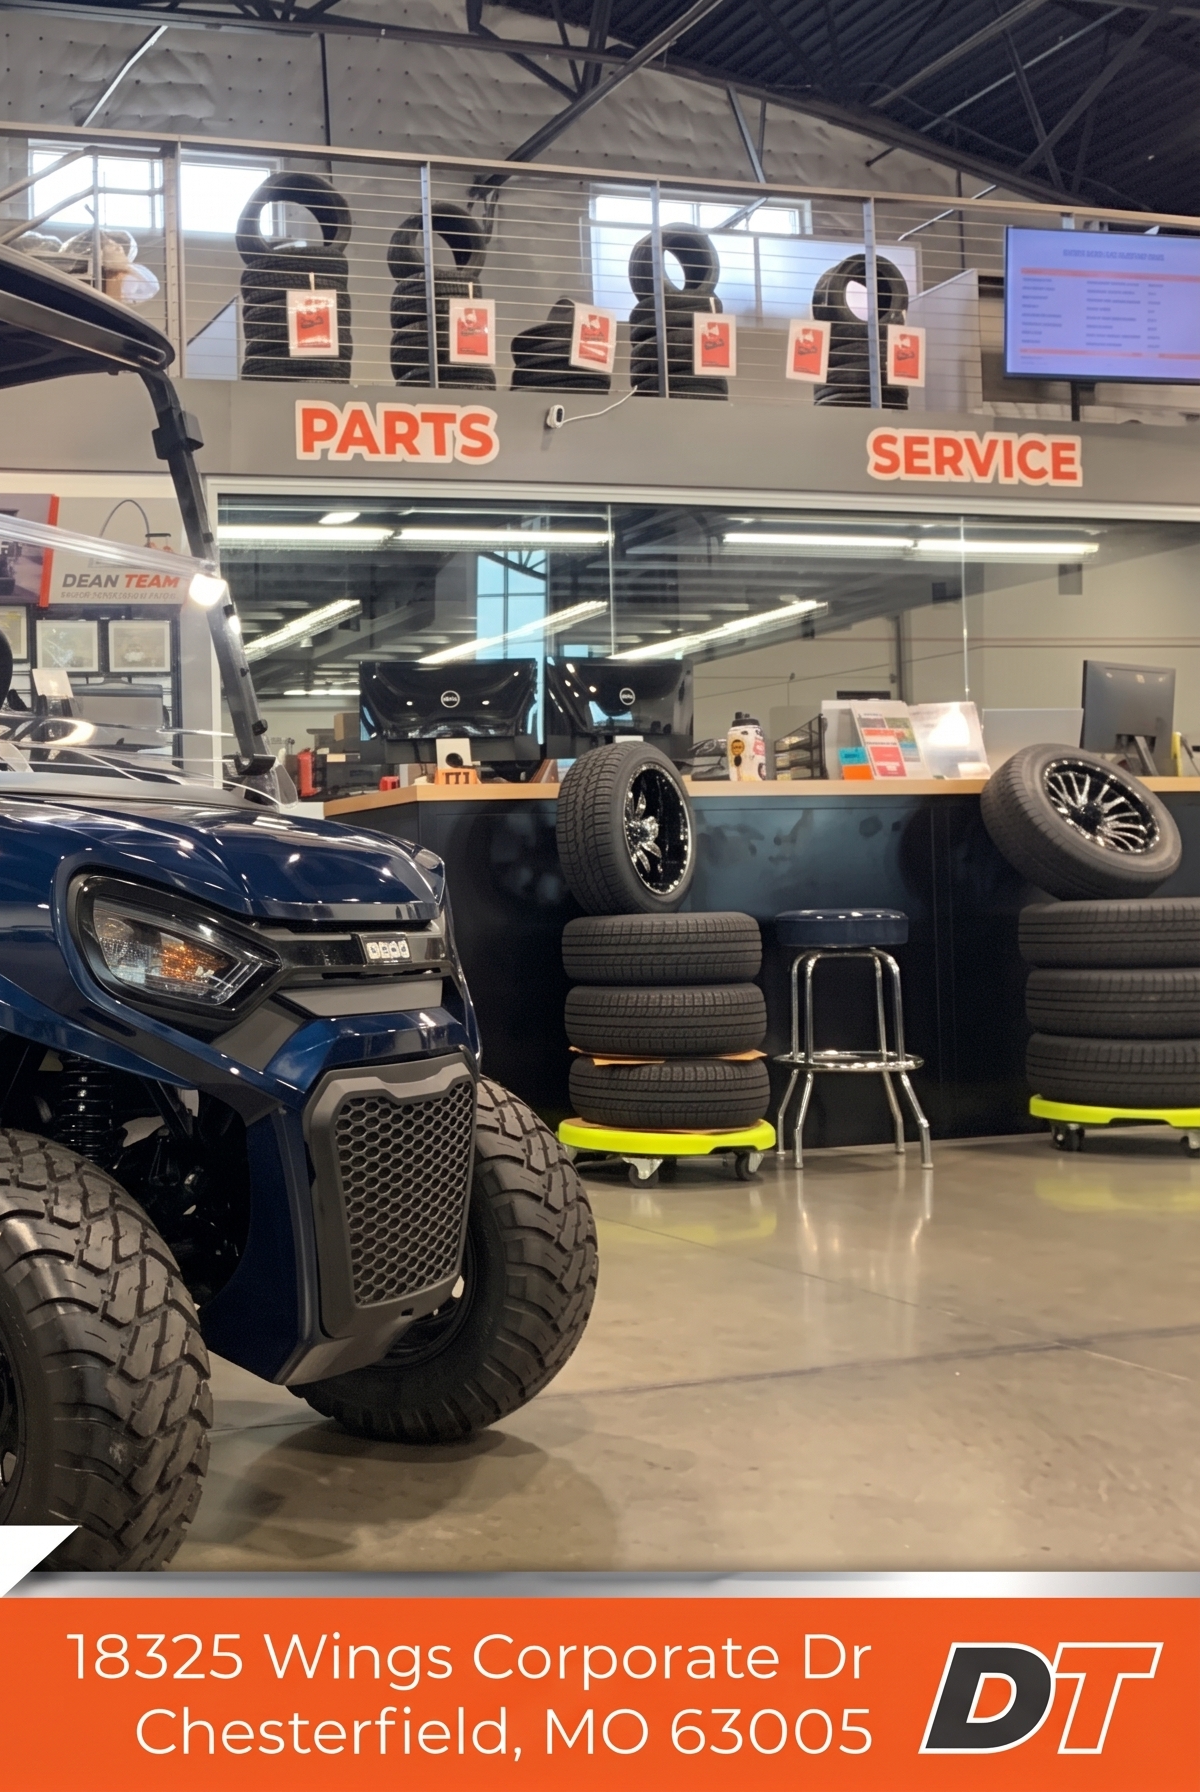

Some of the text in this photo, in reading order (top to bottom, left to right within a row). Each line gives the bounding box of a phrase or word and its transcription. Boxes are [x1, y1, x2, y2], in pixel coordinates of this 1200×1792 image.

[301, 407, 494, 458] PARTS
[872, 433, 1078, 481] SERVICE
[62, 573, 181, 589] DEAN TEAM
